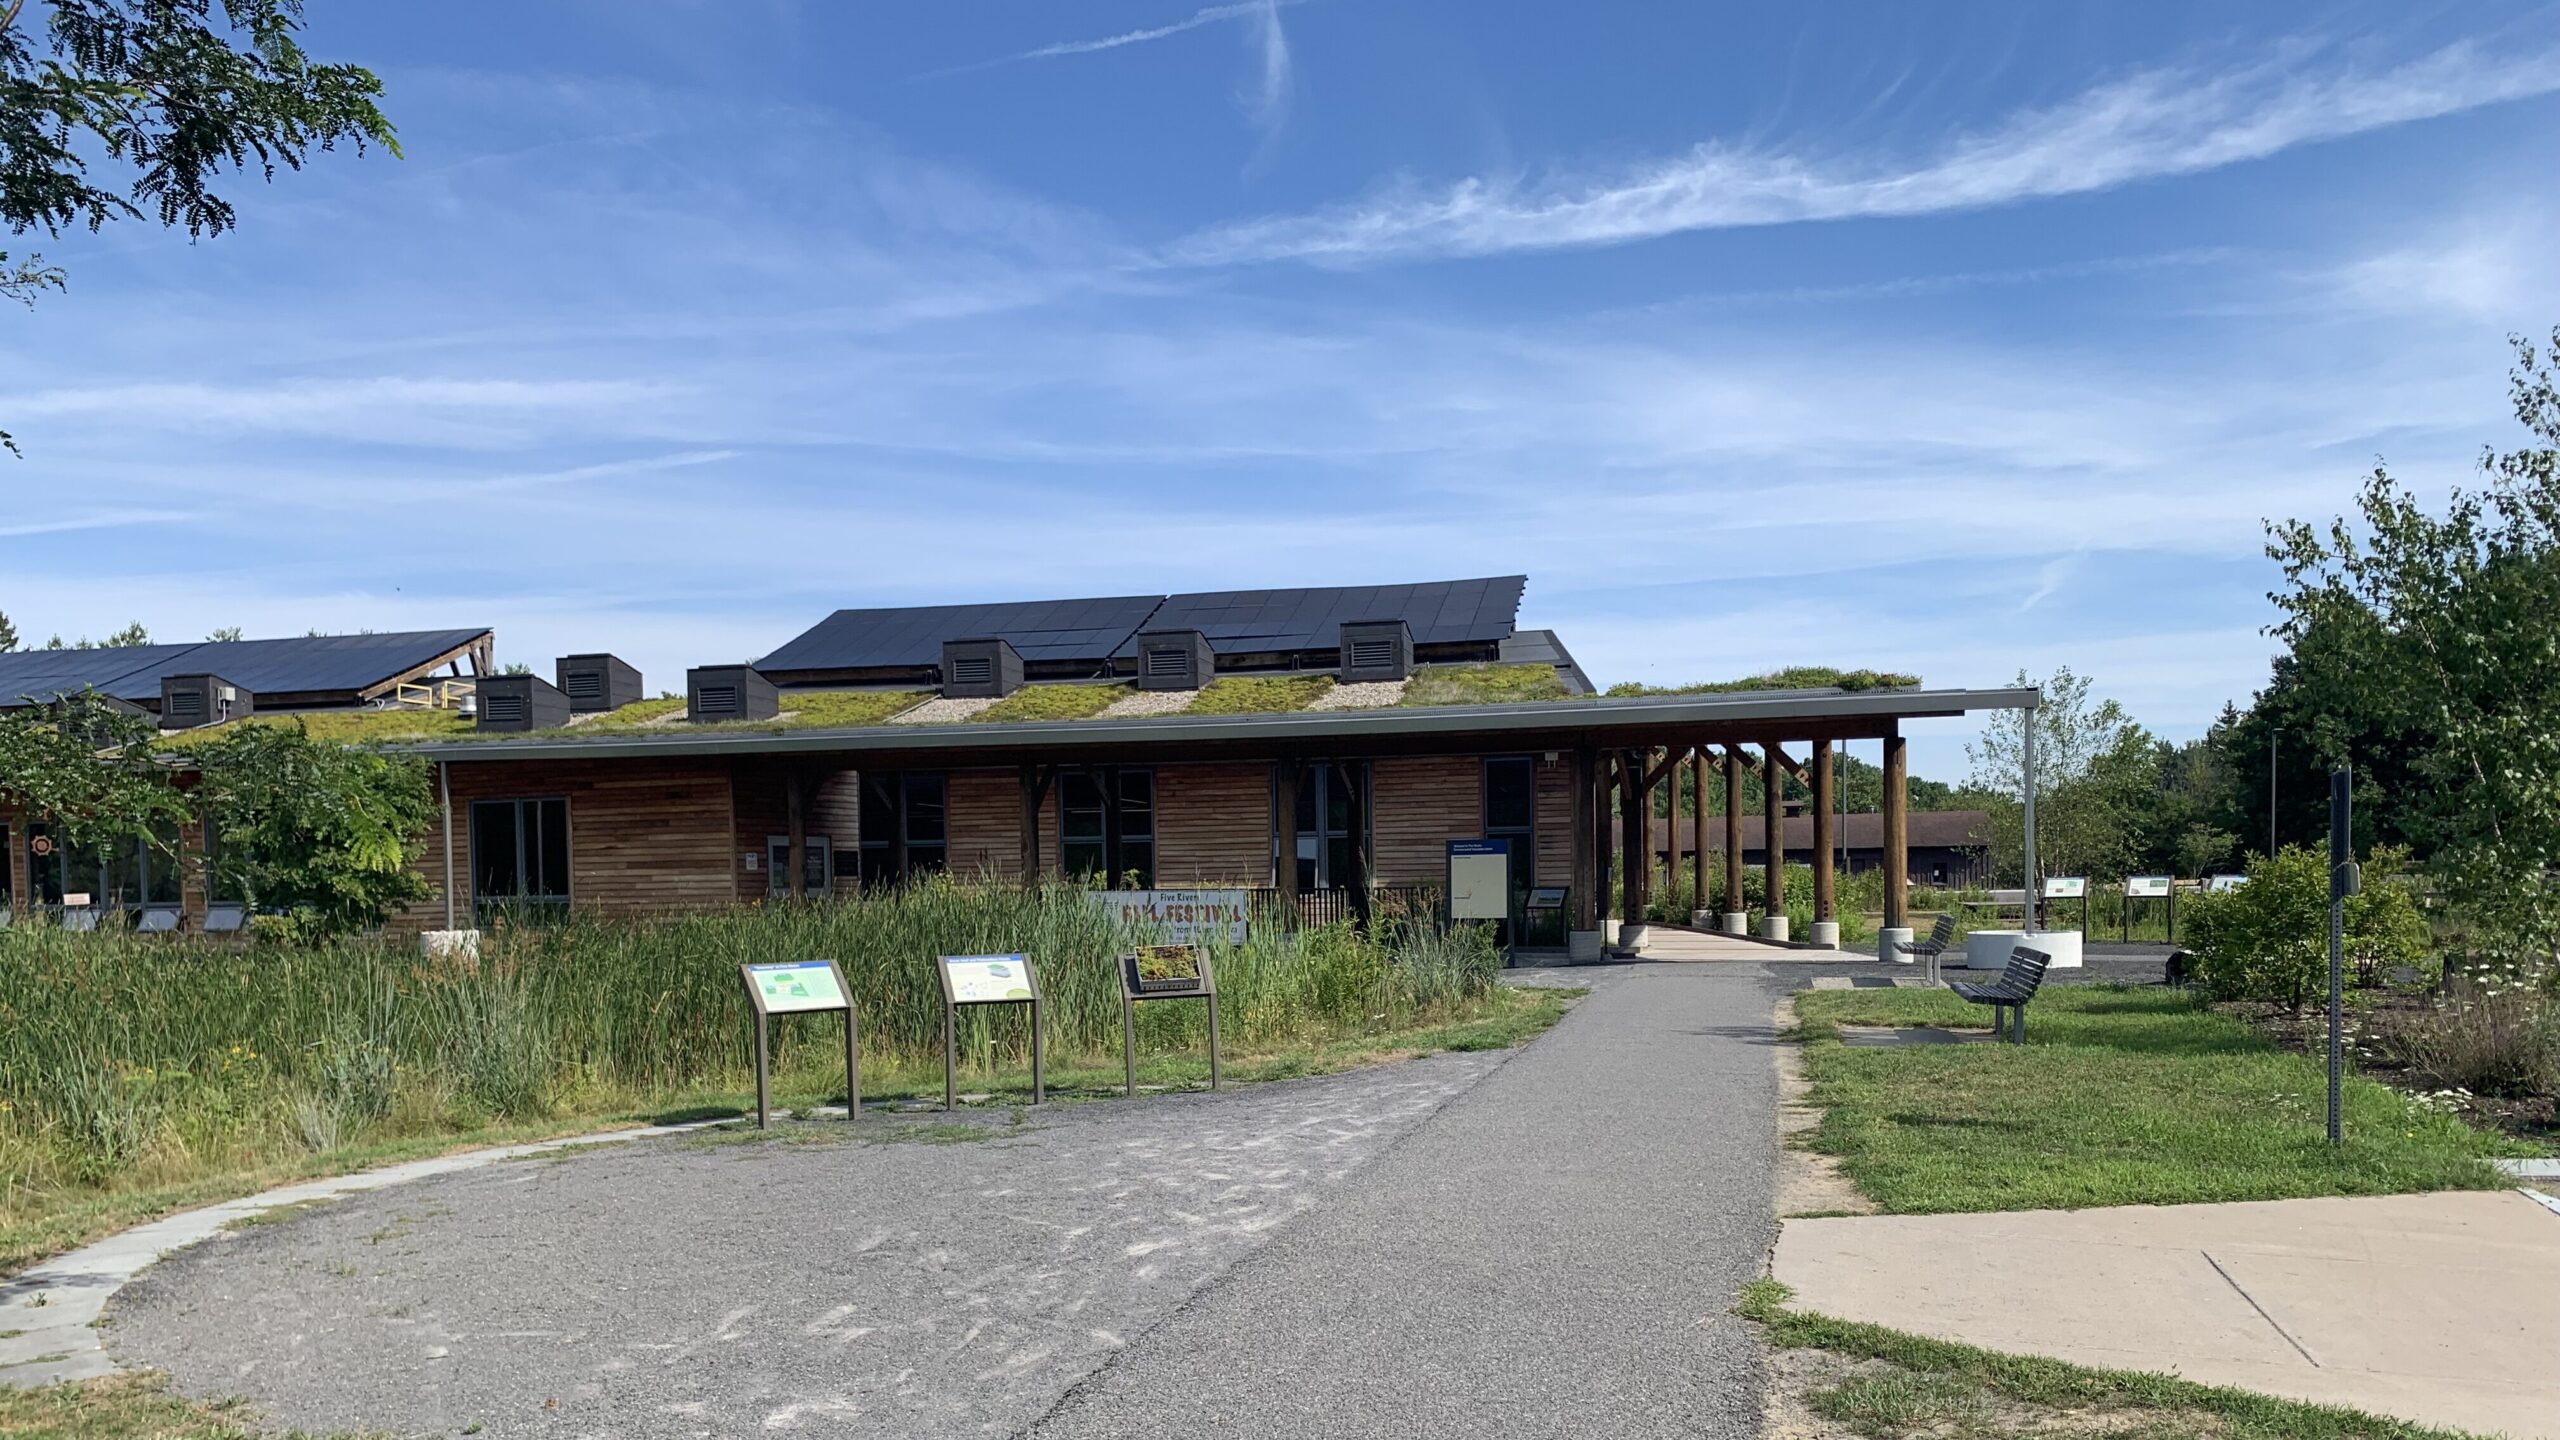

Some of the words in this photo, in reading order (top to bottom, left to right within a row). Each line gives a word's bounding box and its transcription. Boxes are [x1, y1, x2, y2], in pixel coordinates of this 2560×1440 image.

[1160, 893, 1175, 902] Five
[1166, 904, 1241, 924] FESTIVL
[1174, 926, 1191, 934] rom
